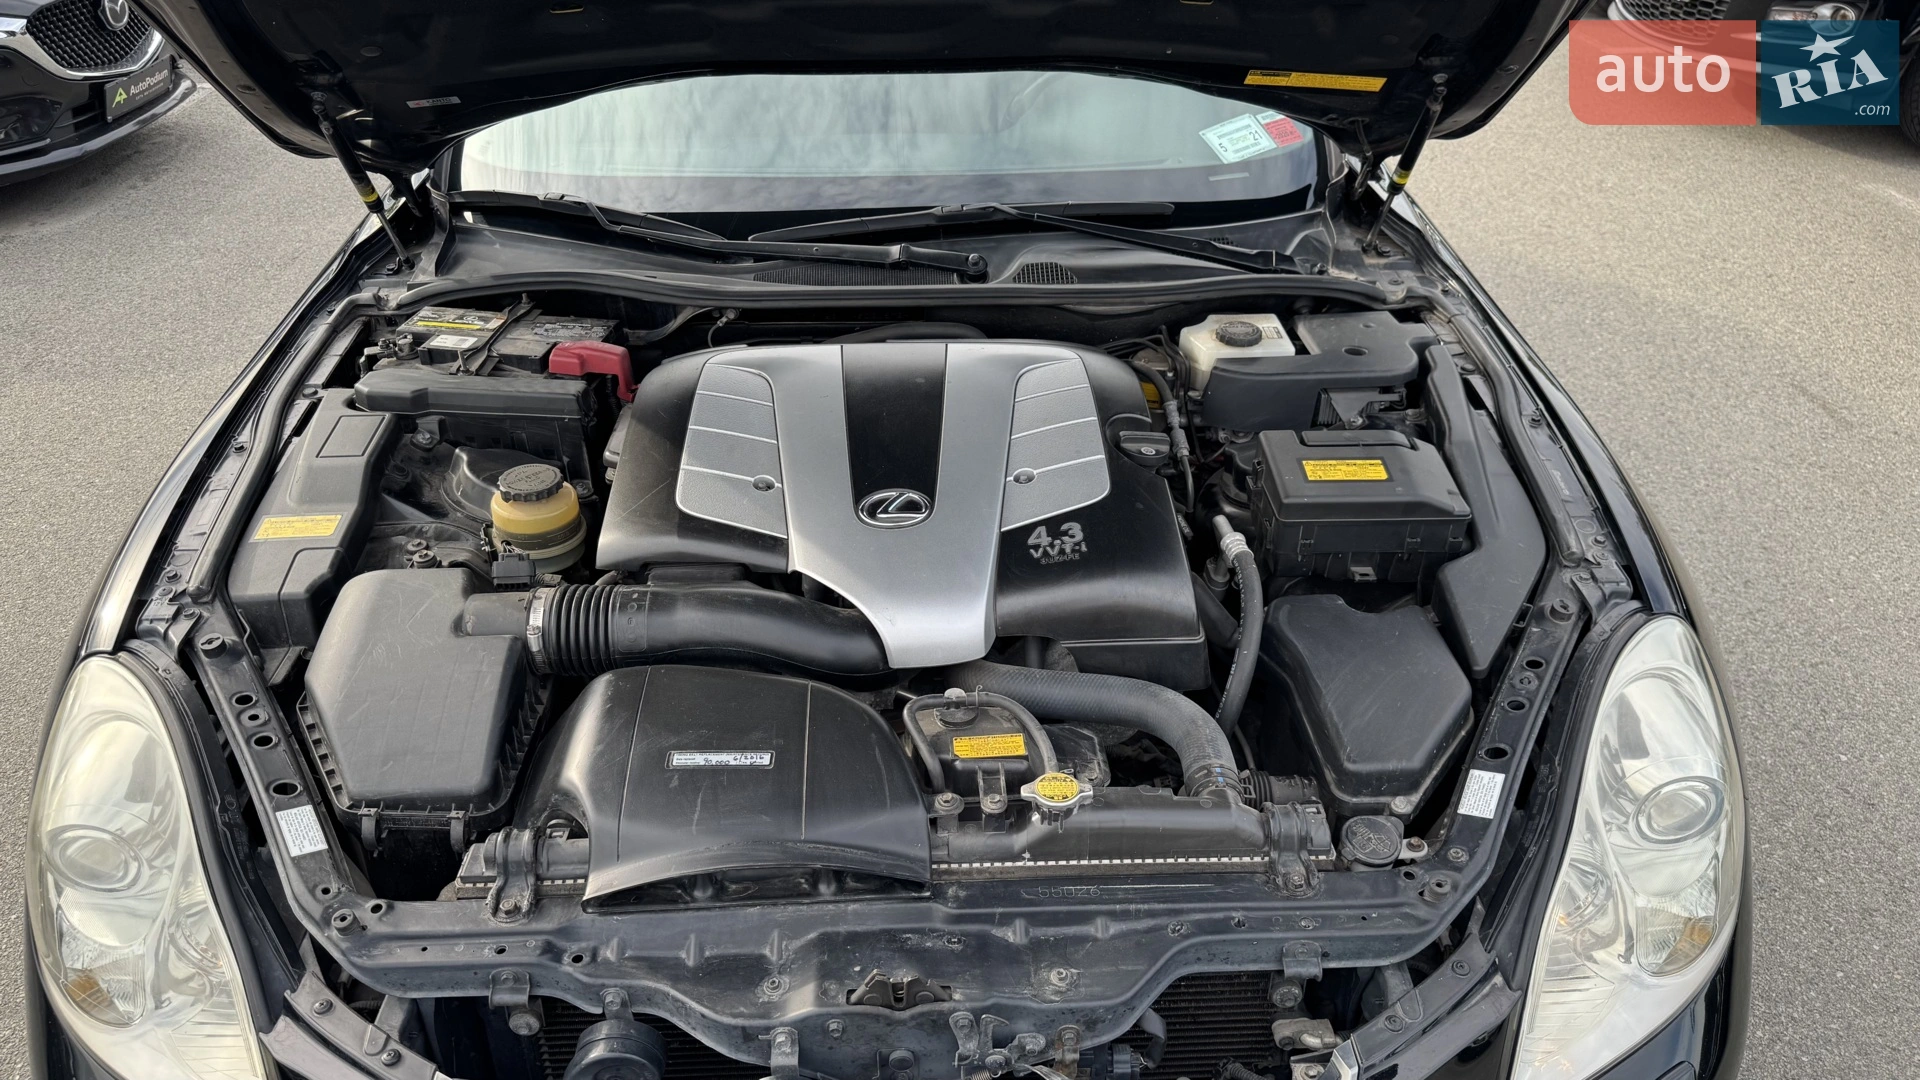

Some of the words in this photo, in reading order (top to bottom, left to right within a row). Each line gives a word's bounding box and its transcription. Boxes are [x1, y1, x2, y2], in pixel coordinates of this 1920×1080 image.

[129, 69, 169, 96] AutoPodium
[1249, 130, 1263, 141] 21
[1218, 142, 1228, 153] 5
[1027, 522, 1084, 546] 4.3
[1037, 884, 1101, 898] 55026
